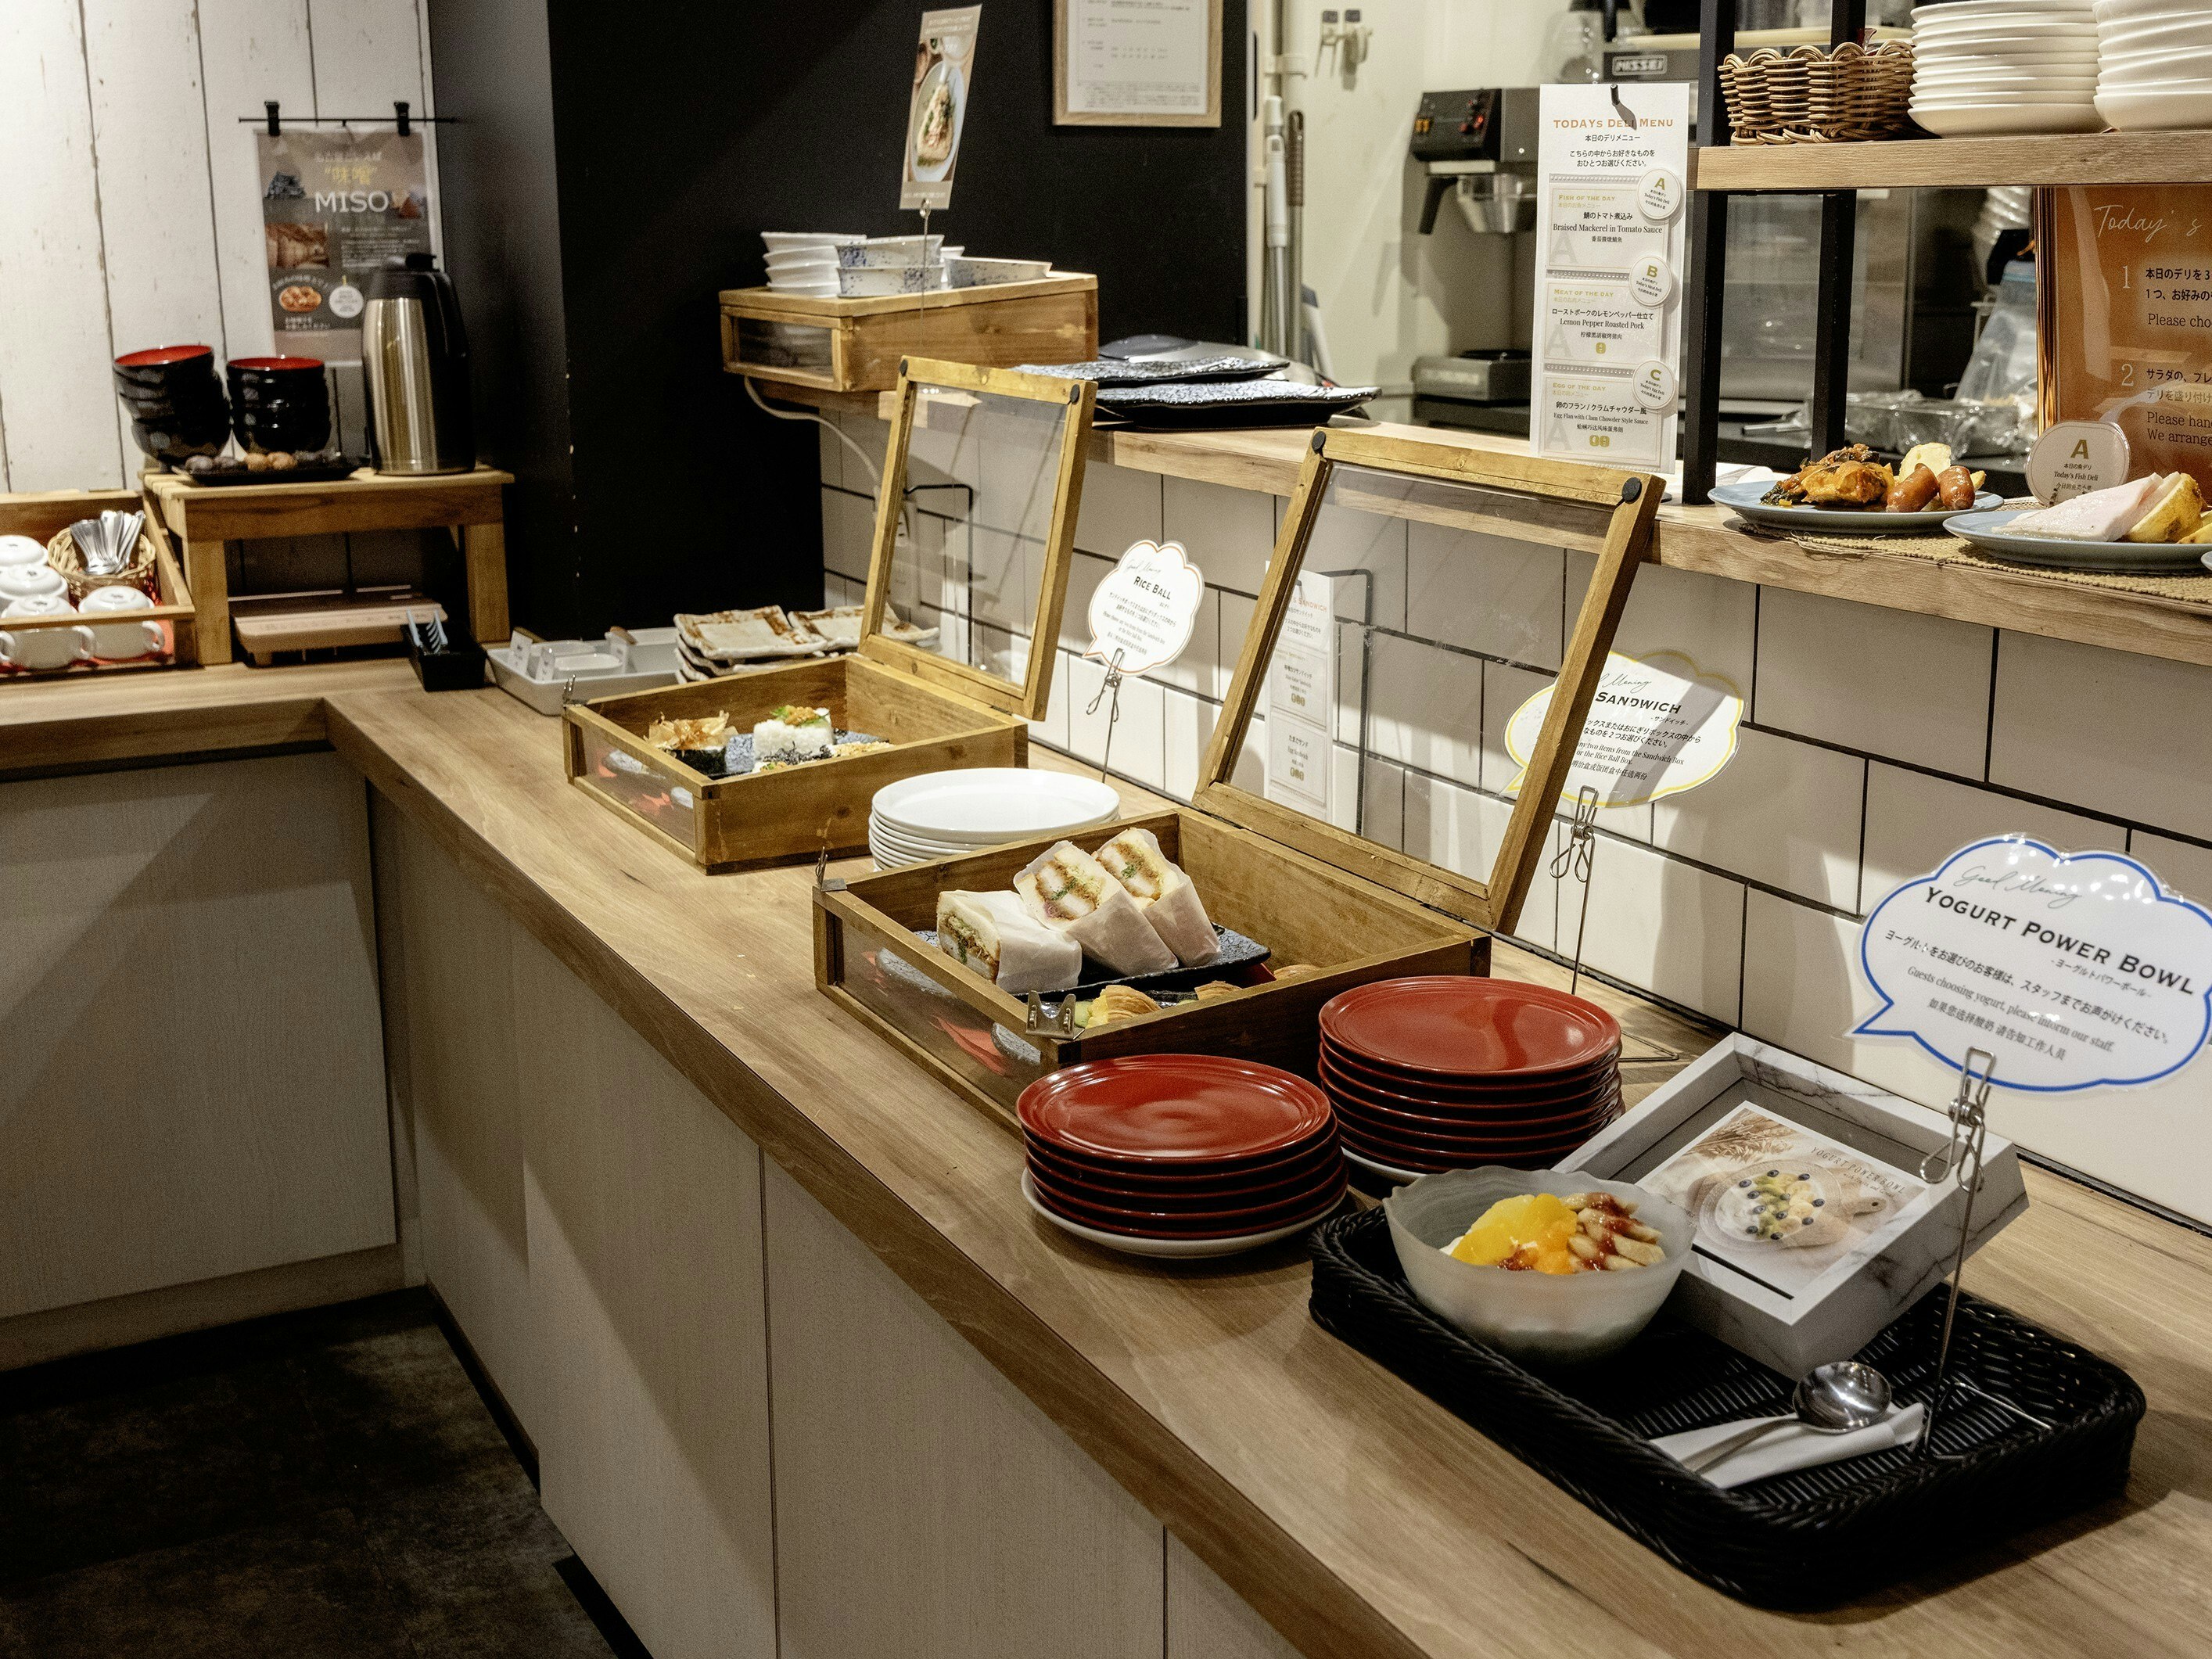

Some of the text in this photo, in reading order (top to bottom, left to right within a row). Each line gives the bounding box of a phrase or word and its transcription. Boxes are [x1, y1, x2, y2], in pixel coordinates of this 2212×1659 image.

[1639, 118, 1674, 127] MENU
[1585, 134, 1641, 142] 本日のデリメニュー
[1577, 159, 1647, 167] おひとつお選びください。
[1654, 177, 1665, 190] A
[314, 190, 390, 213] MISO
[1578, 224, 1608, 232] Mackerel
[1646, 264, 1657, 278] B
[2122, 265, 2131, 289] 1
[2146, 289, 2212, 301] 1つ、お好みの
[1582, 319, 1603, 328] Pepper
[1605, 320, 1628, 329] Roasted
[2147, 313, 2212, 329] Please cho
[1650, 368, 1662, 381] C
[2120, 364, 2134, 387] 2
[2147, 411, 2185, 426] Please
[2147, 428, 2164, 441] We
[2070, 439, 2089, 460] A
[2053, 471, 2074, 479] Today's
[1133, 576, 1172, 601] RICE BALL
[1595, 691, 1682, 714] SANDWICH
[1586, 717, 1701, 744] ックスまたはおにぎりボックスの中から
[1594, 752, 1608, 760] Rice
[1607, 754, 1621, 763] Ball
[1615, 746, 1632, 756] from
[1642, 752, 1672, 764] Sandwich
[1672, 757, 1685, 766] Box
[1925, 886, 2196, 995] YOGURT POWER BOWL
[1908, 965, 1936, 984] Guests
[1936, 977, 1974, 1000] choosing
[1973, 990, 2006, 1011] yogurt,
[2006, 1004, 2037, 1023] please
[2071, 1029, 2089, 1043] our
[1812, 1147, 1905, 1194] YOGURT POWER BOWL
